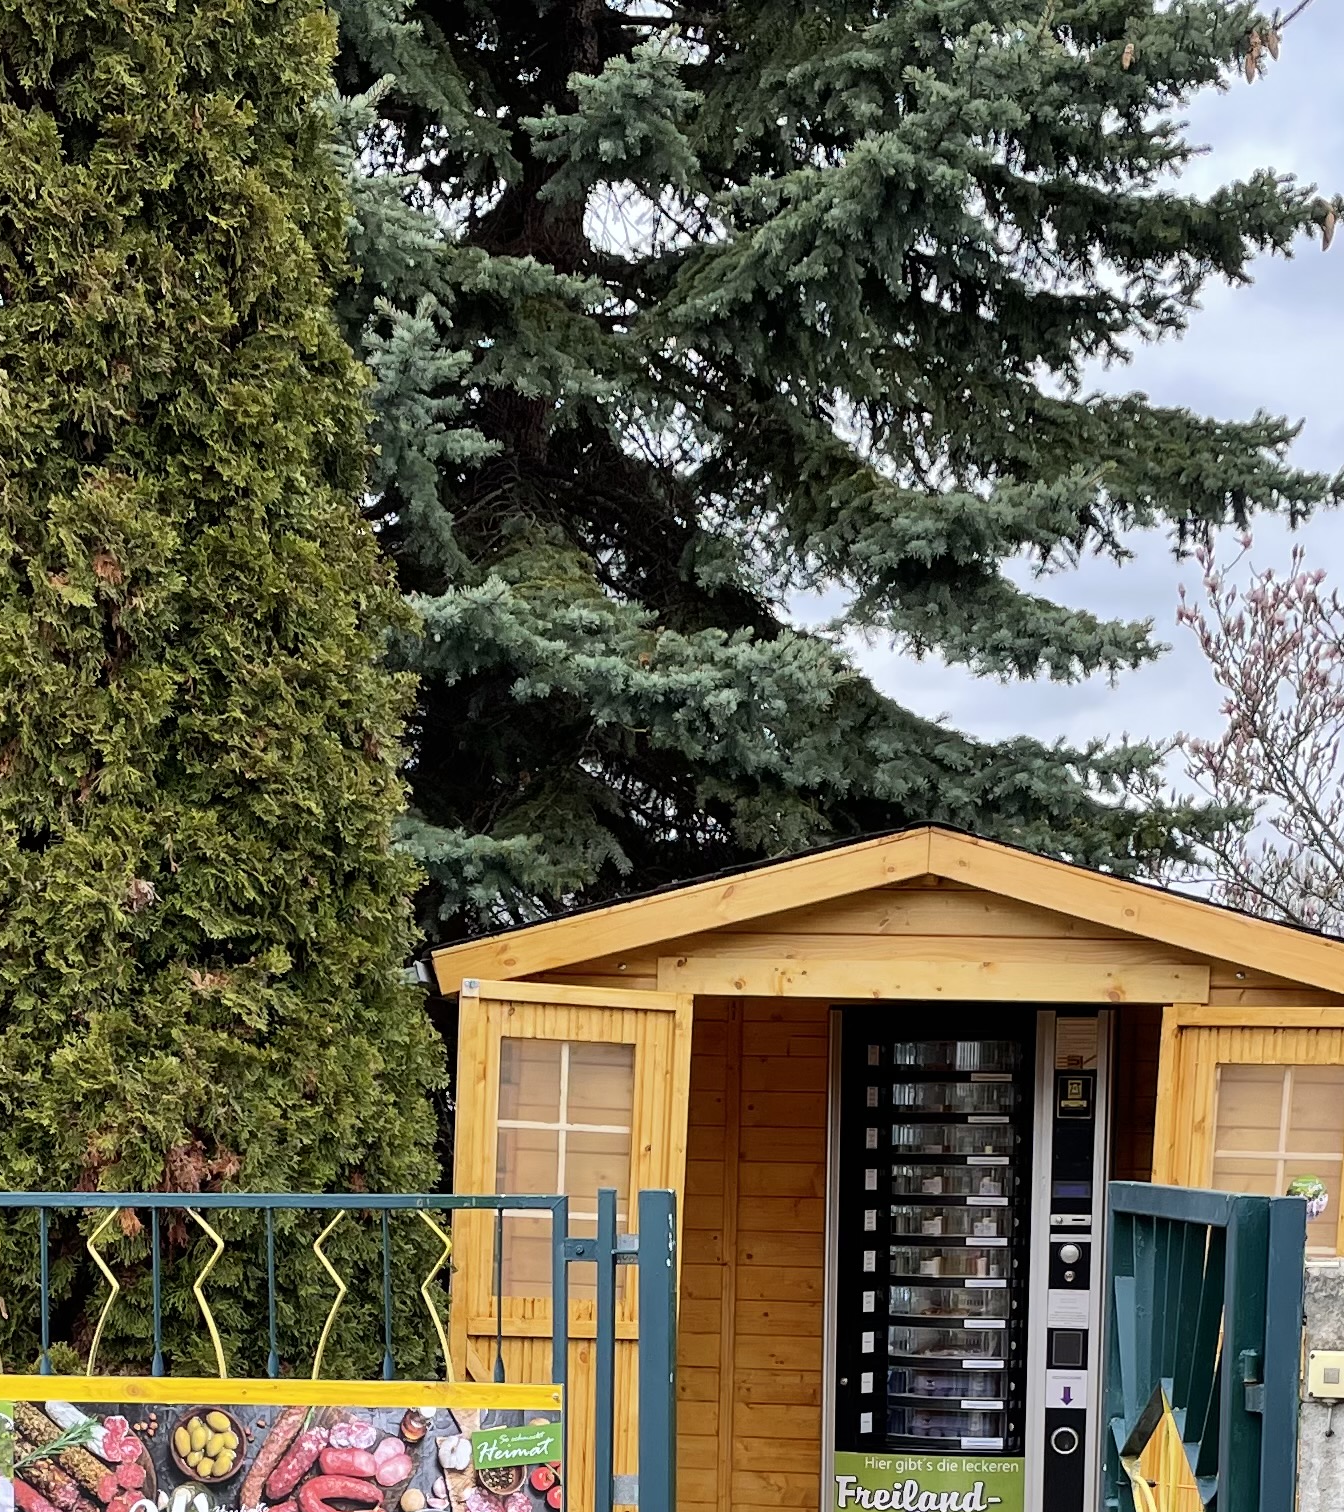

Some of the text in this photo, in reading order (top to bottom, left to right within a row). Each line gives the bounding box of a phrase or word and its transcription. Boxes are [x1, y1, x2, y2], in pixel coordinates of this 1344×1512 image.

[476, 1436, 554, 1463] Heimat
[864, 1456, 892, 1470] Hier
[936, 1458, 958, 1472] die
[962, 1458, 1019, 1473] leckeren
[835, 1475, 1002, 1512] Freiland-
